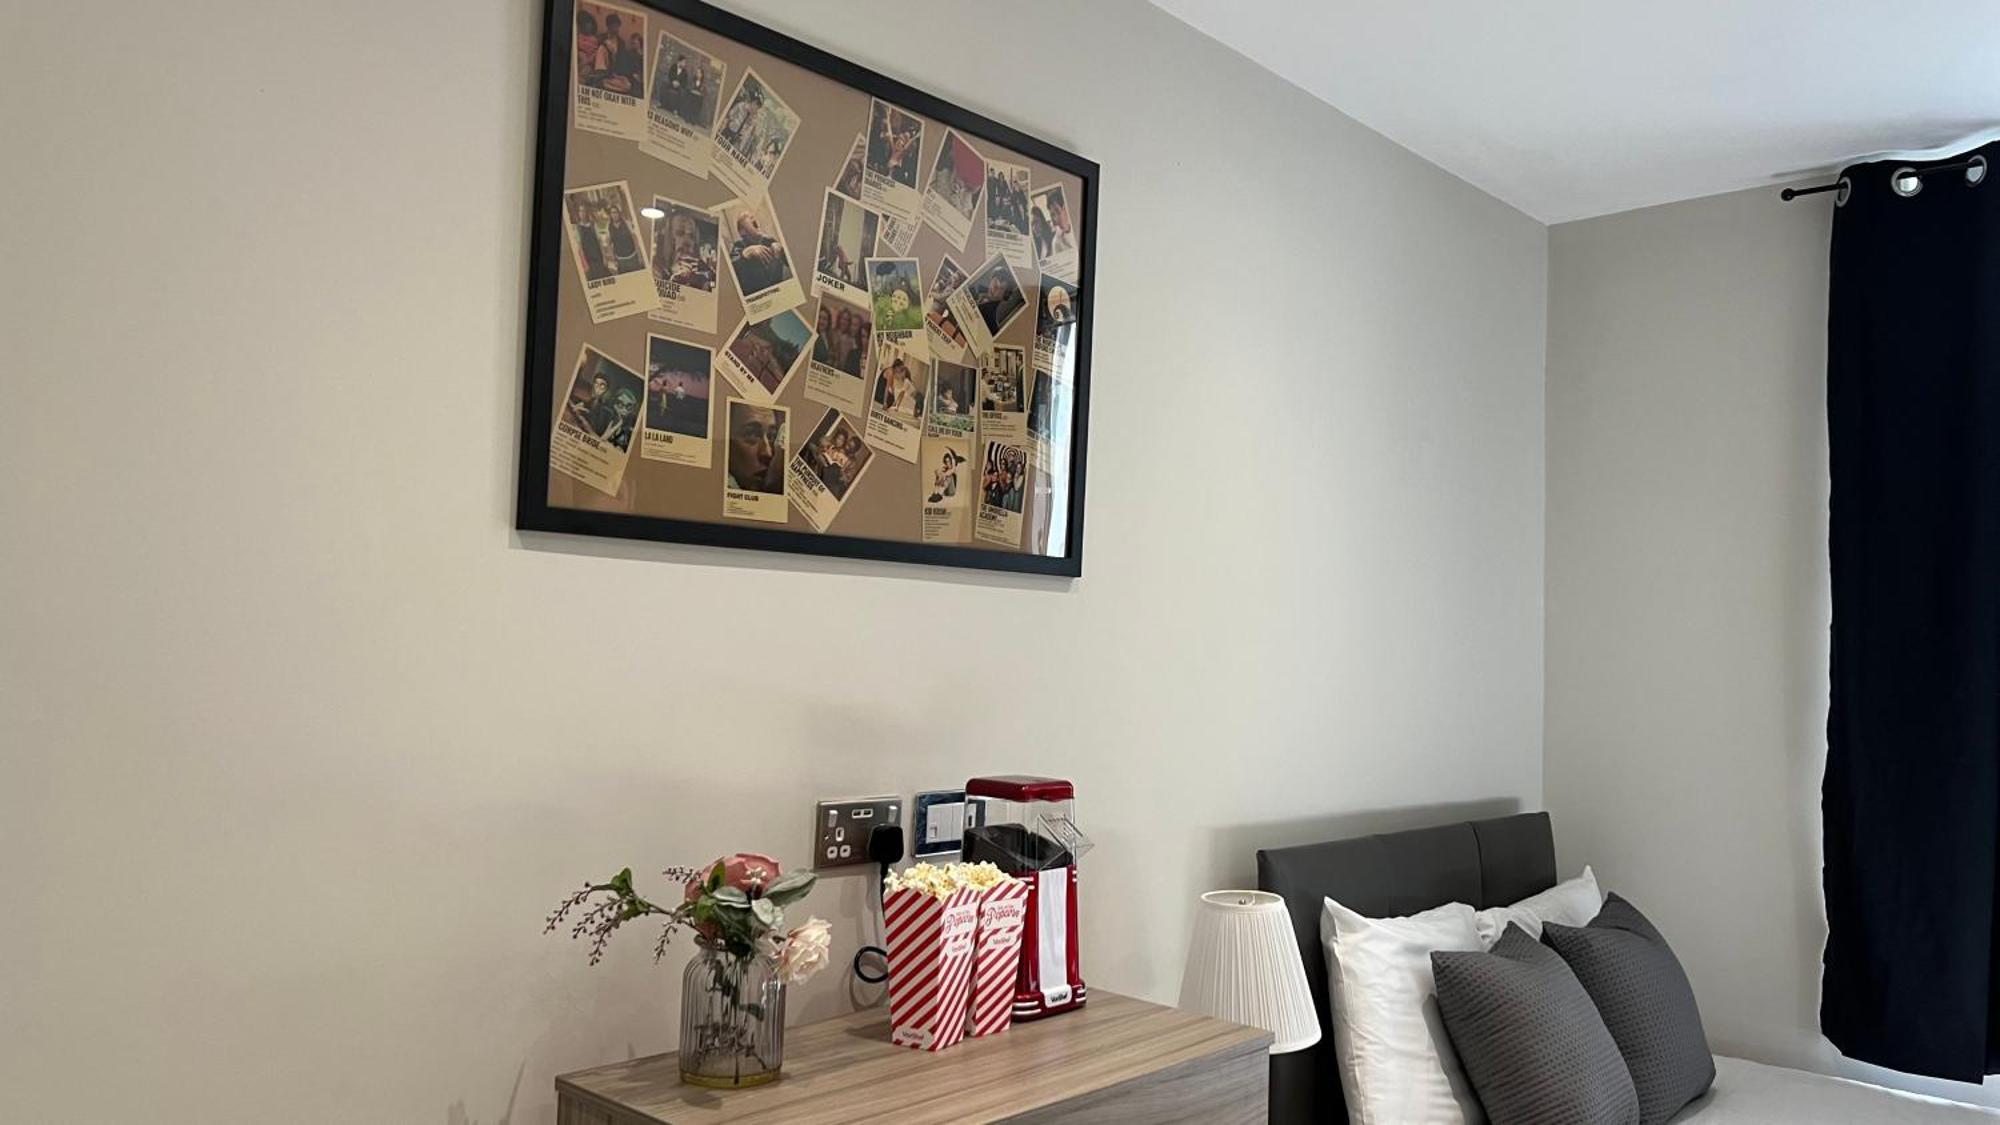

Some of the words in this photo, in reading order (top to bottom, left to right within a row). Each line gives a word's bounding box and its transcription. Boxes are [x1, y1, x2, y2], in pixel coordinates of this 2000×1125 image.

[714, 133, 731, 154] YOUR
[816, 274, 845, 292] JOKER
[724, 350, 741, 368] STAND
[557, 422, 583, 443] CORPSE
[727, 492, 743, 501] FIGHT
